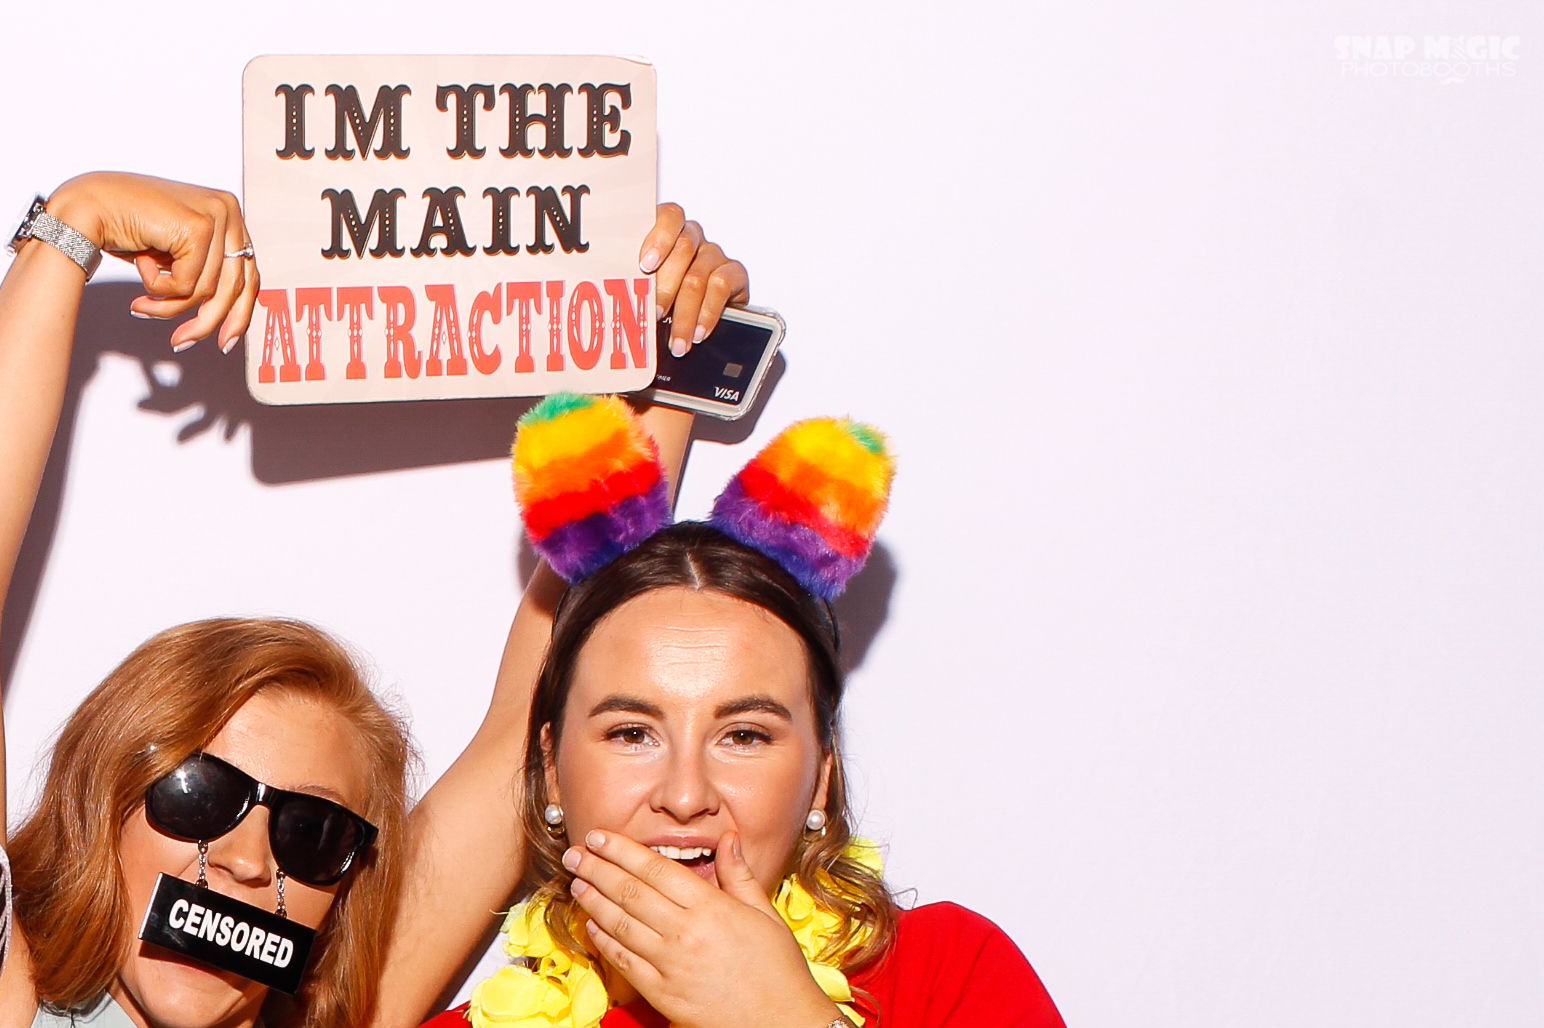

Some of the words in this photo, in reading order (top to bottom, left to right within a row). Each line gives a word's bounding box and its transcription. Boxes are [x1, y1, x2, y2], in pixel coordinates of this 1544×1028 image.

[274, 83, 412, 161] IM
[435, 82, 632, 159] THE
[320, 184, 591, 260] MAIN
[258, 277, 651, 384] ATTRACTION
[714, 386, 740, 401] VISA
[169, 898, 294, 969] CENSORED
